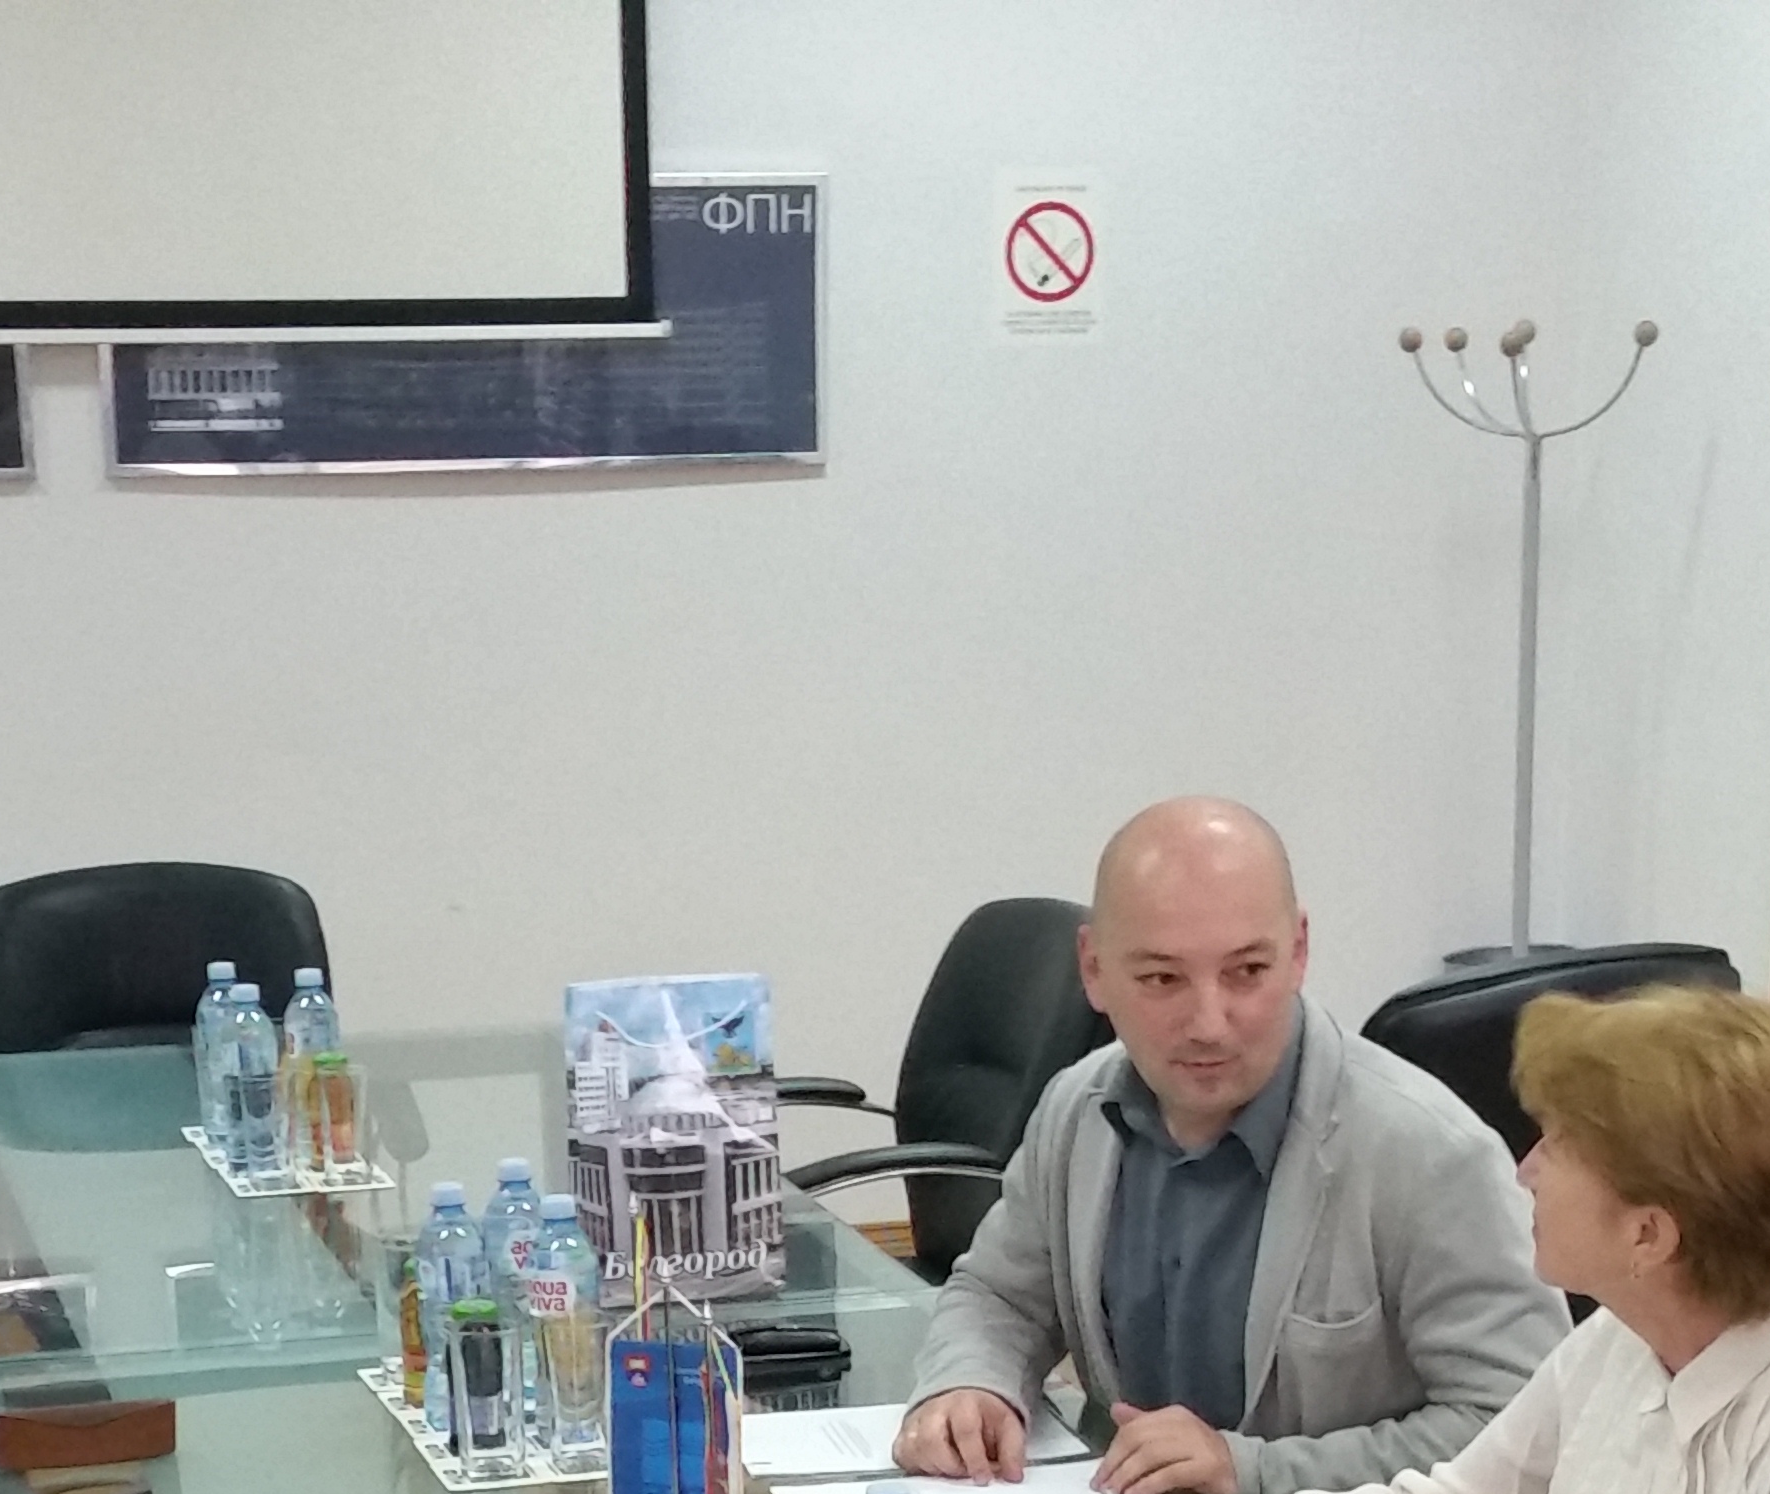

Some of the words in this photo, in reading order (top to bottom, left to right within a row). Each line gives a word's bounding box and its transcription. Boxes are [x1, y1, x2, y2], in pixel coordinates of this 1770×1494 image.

[702, 192, 812, 235] ФПН
[603, 1239, 767, 1280] Блгород
[530, 1281, 567, 1295] qua
